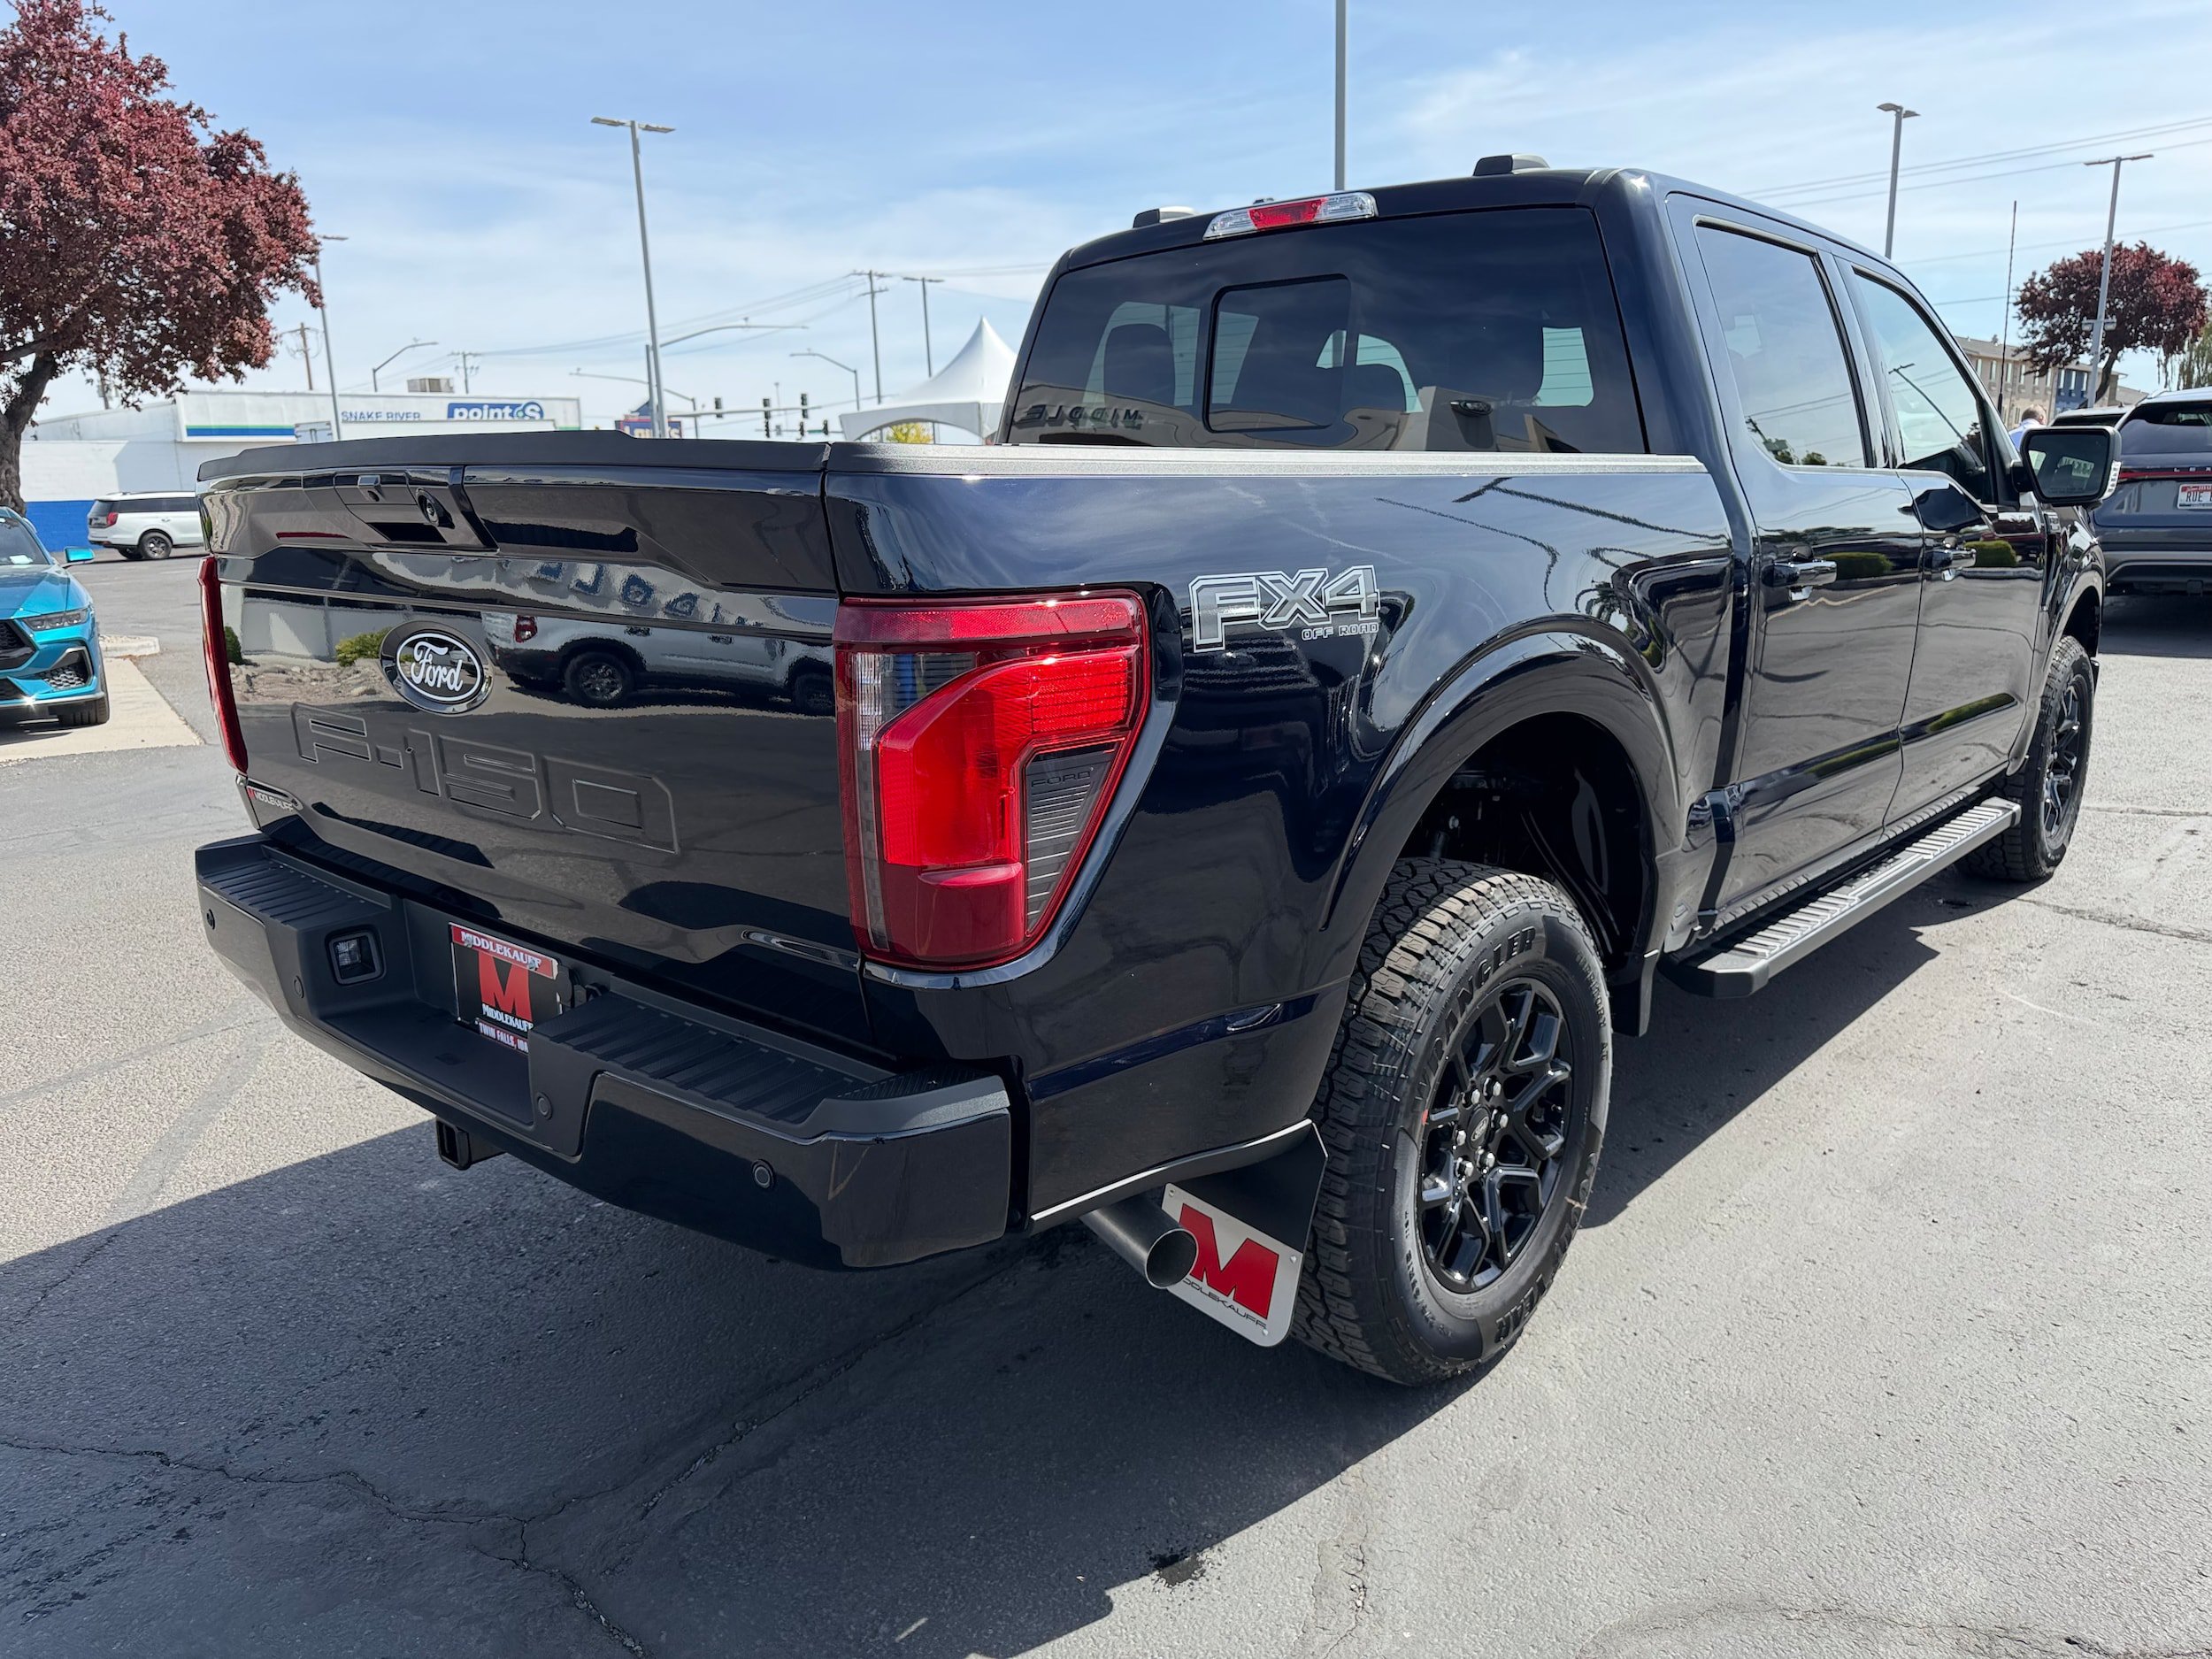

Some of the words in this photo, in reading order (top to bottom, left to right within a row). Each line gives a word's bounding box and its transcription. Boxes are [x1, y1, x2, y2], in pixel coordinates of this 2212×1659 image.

[341, 411, 382, 421] SNAKE
[386, 411, 420, 421] RIVER
[1189, 565, 1380, 653] FX4
[1302, 625, 1333, 641] OFF
[1338, 622, 1379, 637] ROAD
[410, 640, 463, 692] Ford
[291, 702, 681, 855] F-150
[1031, 771, 1091, 787] FORD
[478, 950, 533, 1022] M
[479, 1022, 496, 1039] TWIN
[1179, 1203, 1279, 1320] M
